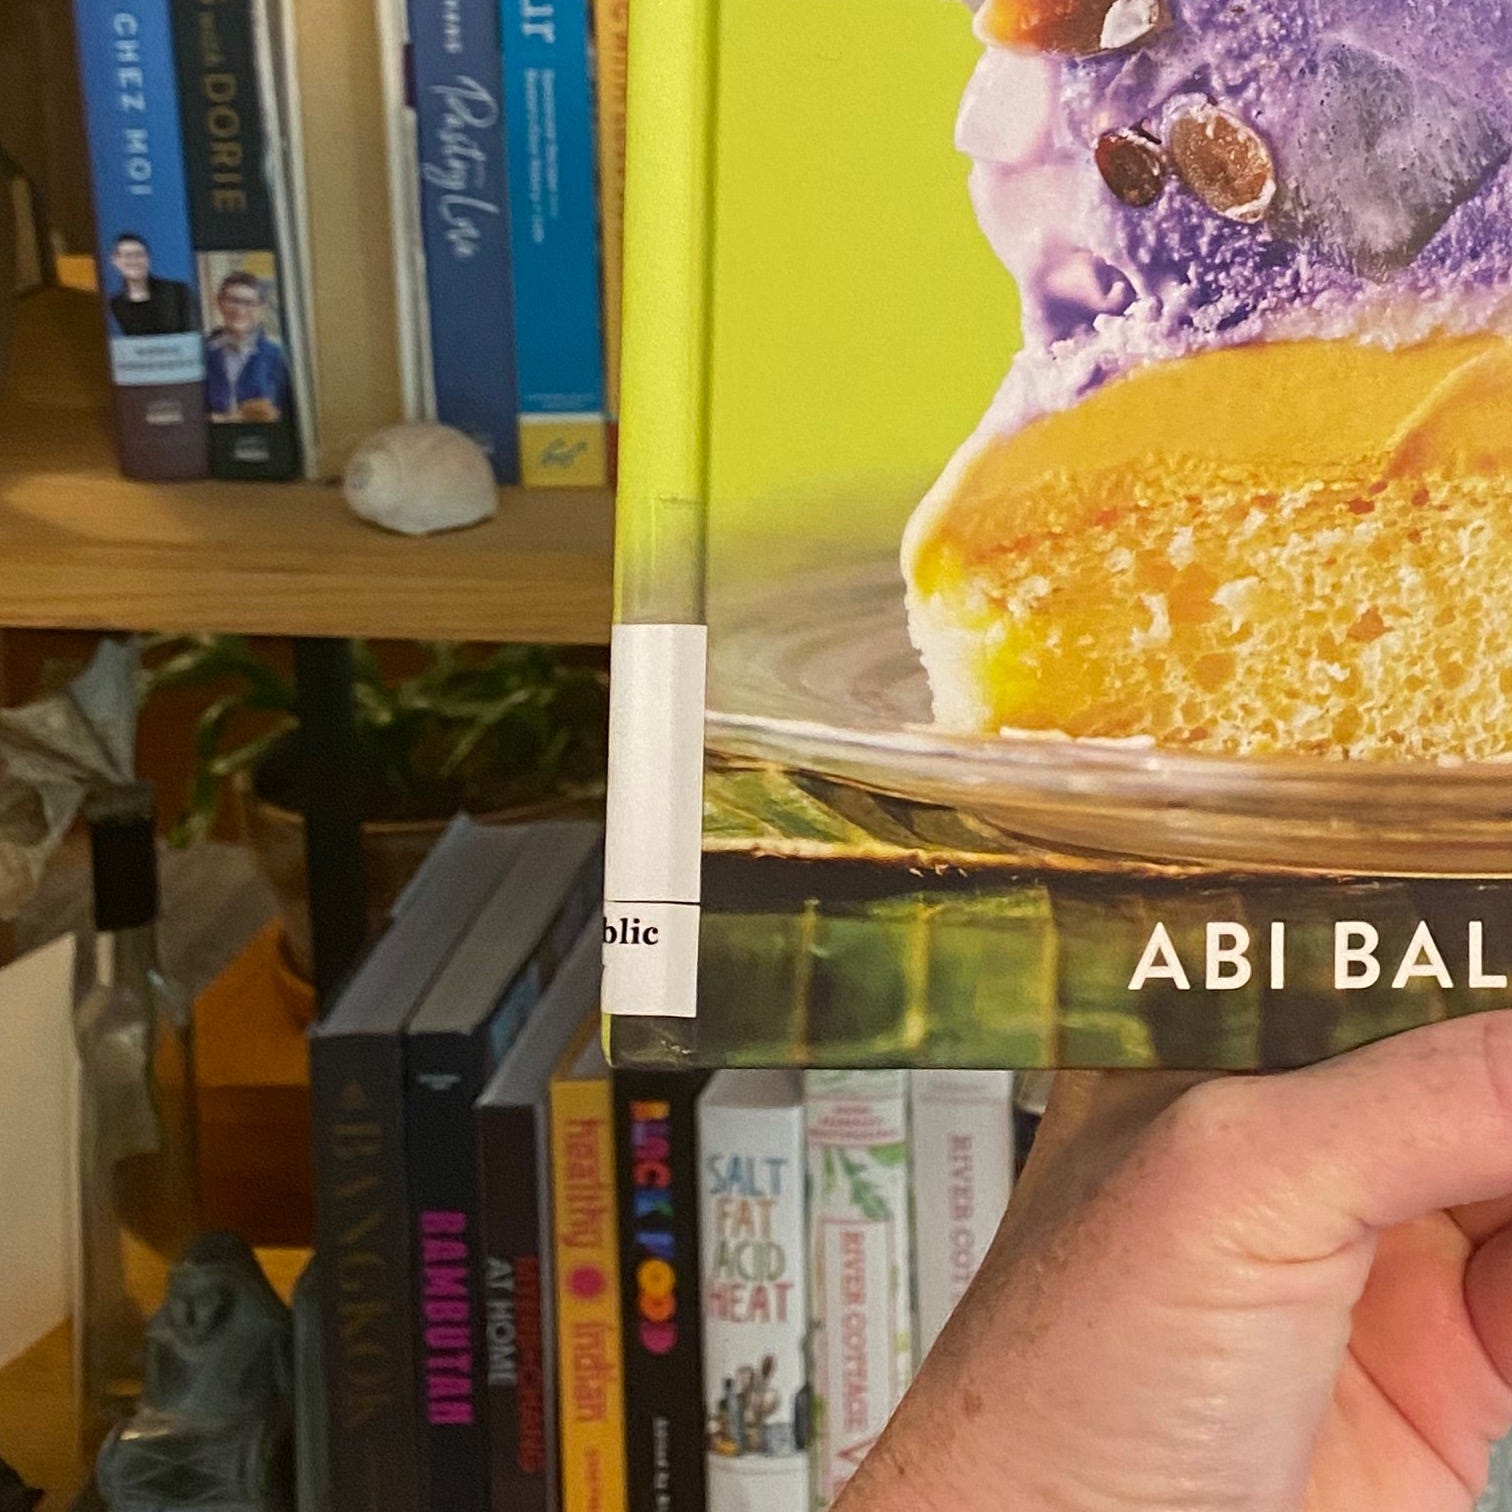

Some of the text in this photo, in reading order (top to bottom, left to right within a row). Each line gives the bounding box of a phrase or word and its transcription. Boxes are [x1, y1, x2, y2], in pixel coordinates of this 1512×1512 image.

[111, 12, 147, 114] CHEZ
[124, 128, 154, 196] MOI
[203, 71, 248, 214] DORIE
[602, 916, 659, 946] blic
[1127, 920, 1287, 993] ABI
[562, 1117, 609, 1251] healthy
[706, 1152, 788, 1197] SALT
[949, 1134, 975, 1219] RIVER
[714, 1196, 776, 1237] FAT
[712, 1240, 786, 1282] ACID
[840, 1230, 868, 1306] RIVER
[419, 1210, 475, 1426] RAMBUTAN
[486, 1257, 517, 1387] AT HOME
[705, 1280, 794, 1324] HEAT
[566, 1321, 613, 1425] Indian
[841, 1310, 869, 1433] COTTAGE
